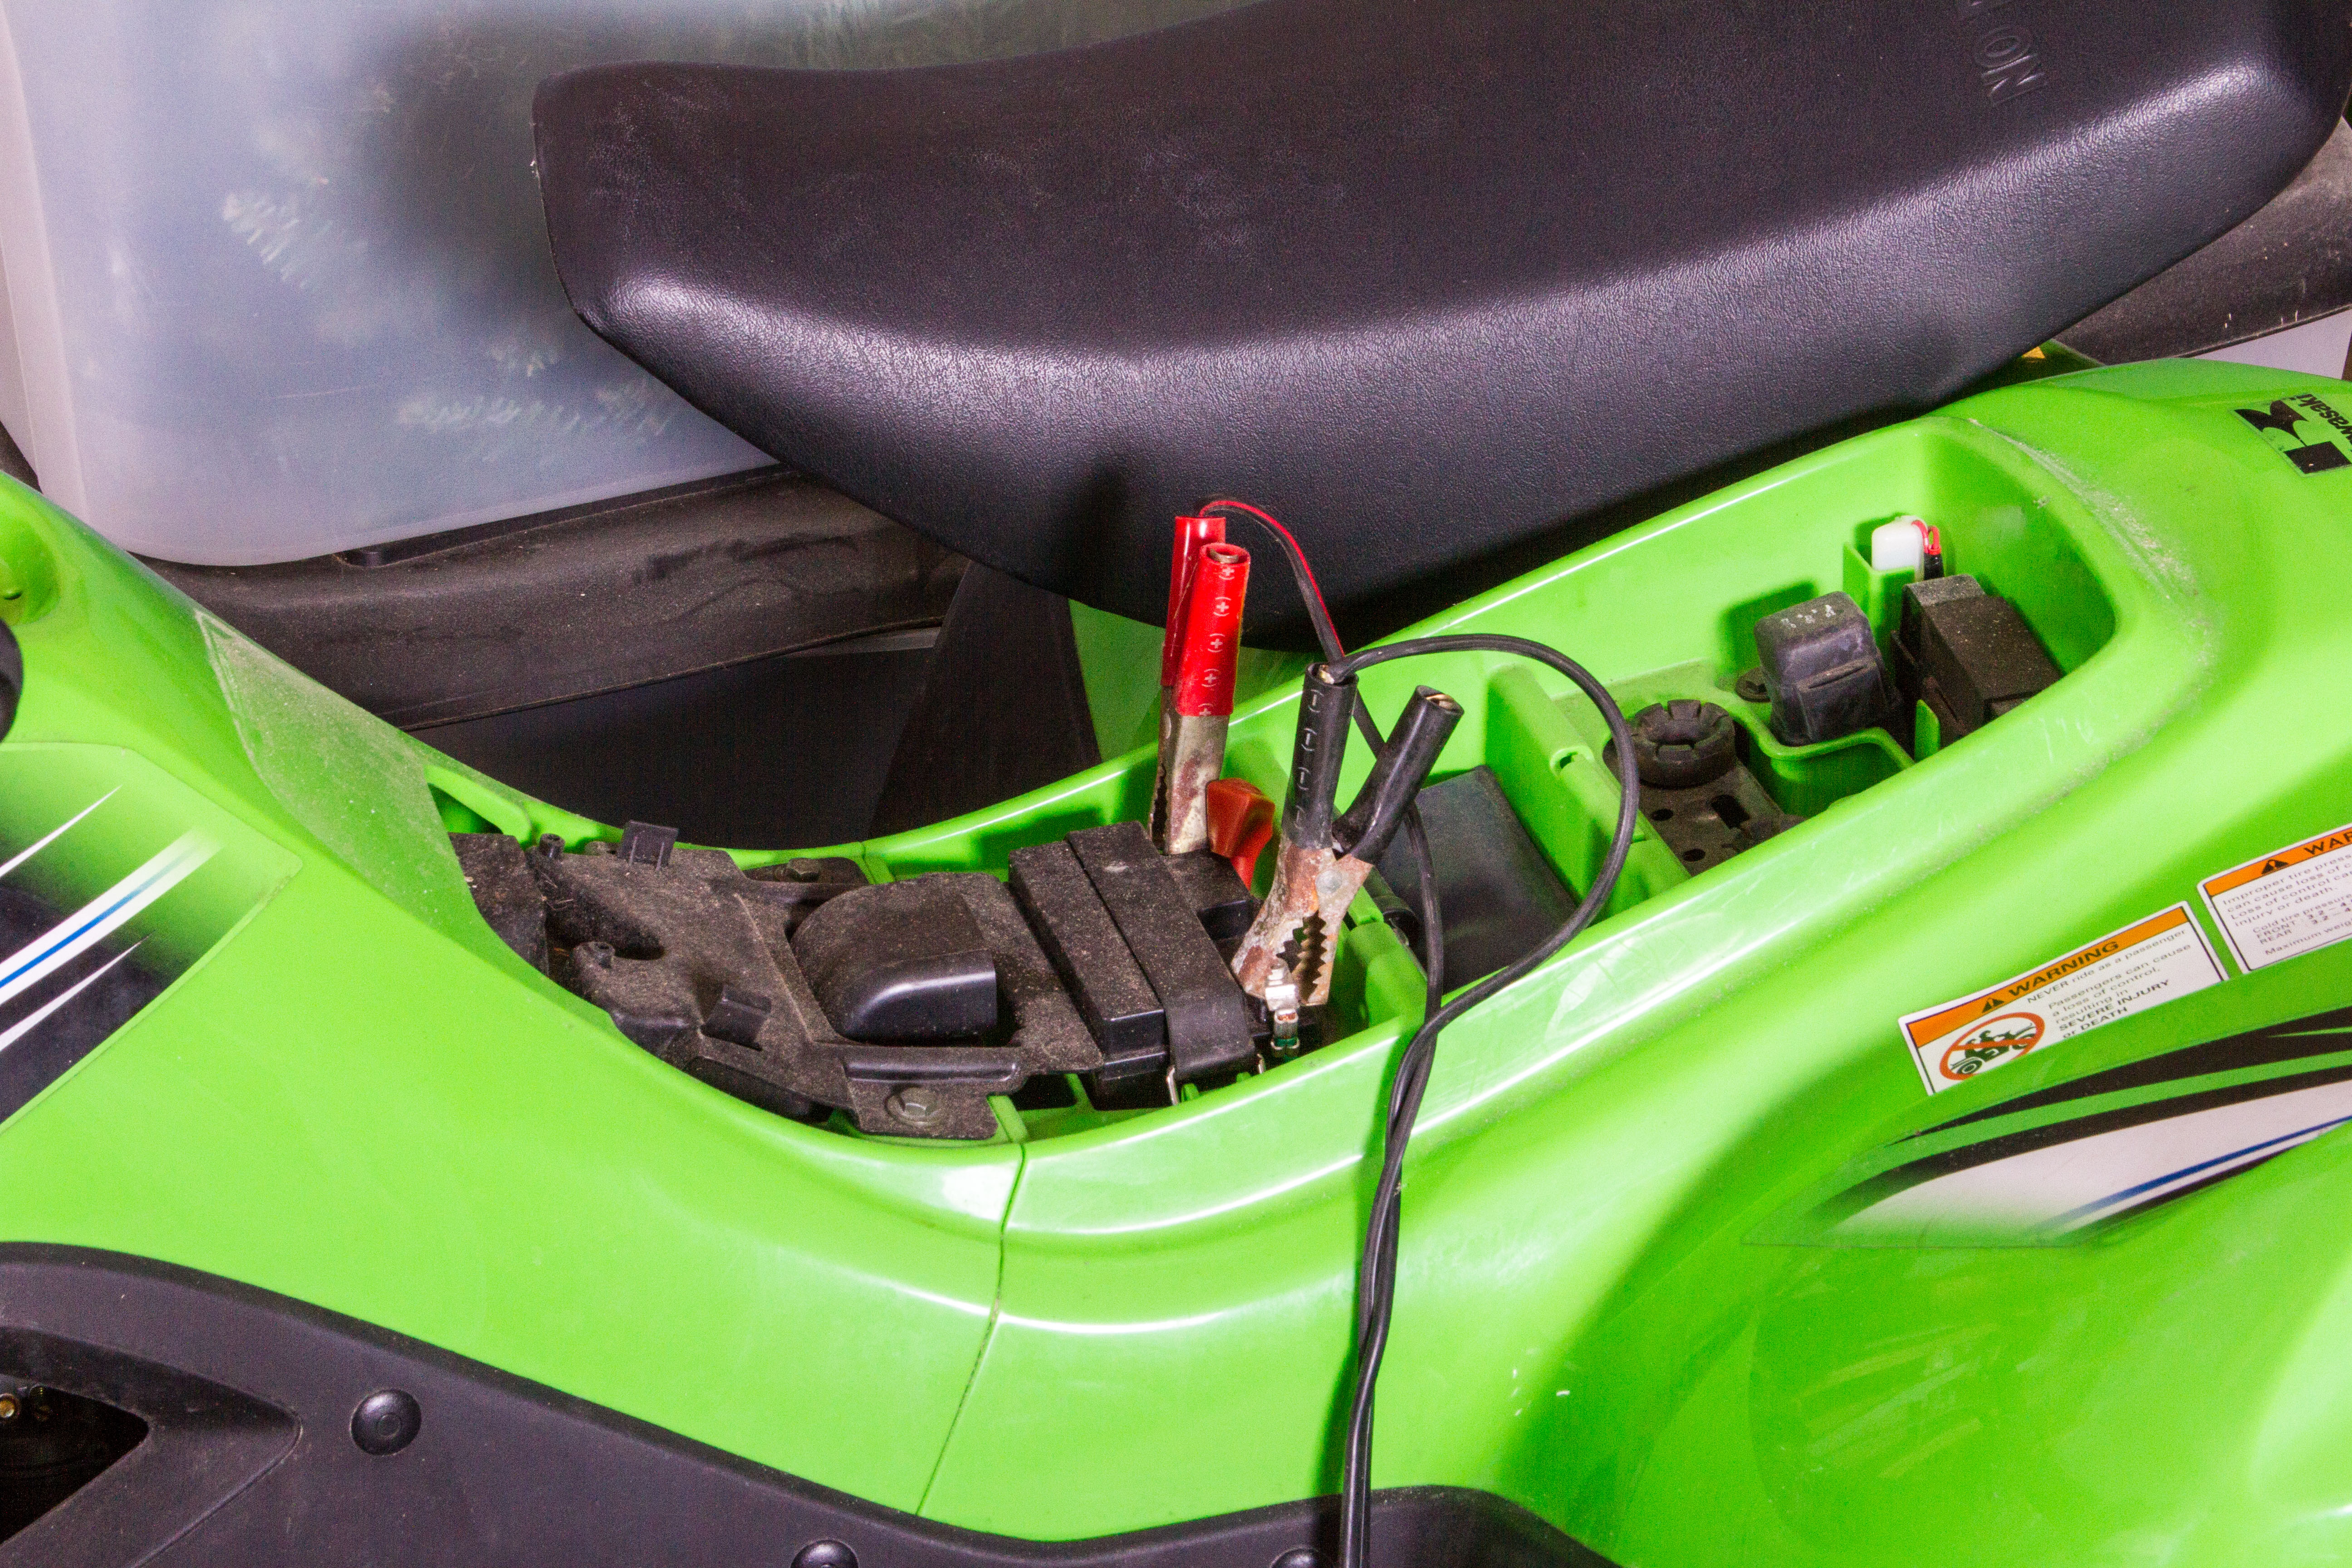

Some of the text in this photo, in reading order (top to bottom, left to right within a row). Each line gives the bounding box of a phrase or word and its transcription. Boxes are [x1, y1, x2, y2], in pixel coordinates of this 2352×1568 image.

[2288, 394, 2352, 452] wasaki
[2223, 878, 2285, 906] Improper
[2288, 868, 2311, 879] tire
[2227, 901, 2251, 912] can
[2254, 884, 2293, 902] cause
[2296, 872, 2323, 885] loss
[2328, 865, 2340, 874] of
[2231, 871, 2352, 920] Loss of control ca
[2253, 920, 2278, 933] Cold
[2281, 912, 2300, 922] tire
[2277, 902, 2290, 911] or
[2260, 929, 2292, 945] REAR
[2265, 917, 2352, 955] Maximum weig
[2008, 941, 2119, 997] WARNING
[2027, 980, 2069, 1004] NEVER
[2072, 970, 2095, 983] ride
[2098, 962, 2112, 971] as
[2125, 929, 2186, 960] passenger
[2048, 945, 2191, 1009] Passengers can cause
[2056, 988, 2128, 1024] resulting in
[2059, 979, 2169, 1031] SEVERE INJURY
[2063, 998, 2090, 1012] loss
[2094, 987, 2106, 998] of
[2063, 1006, 2128, 1039] or DEATH
